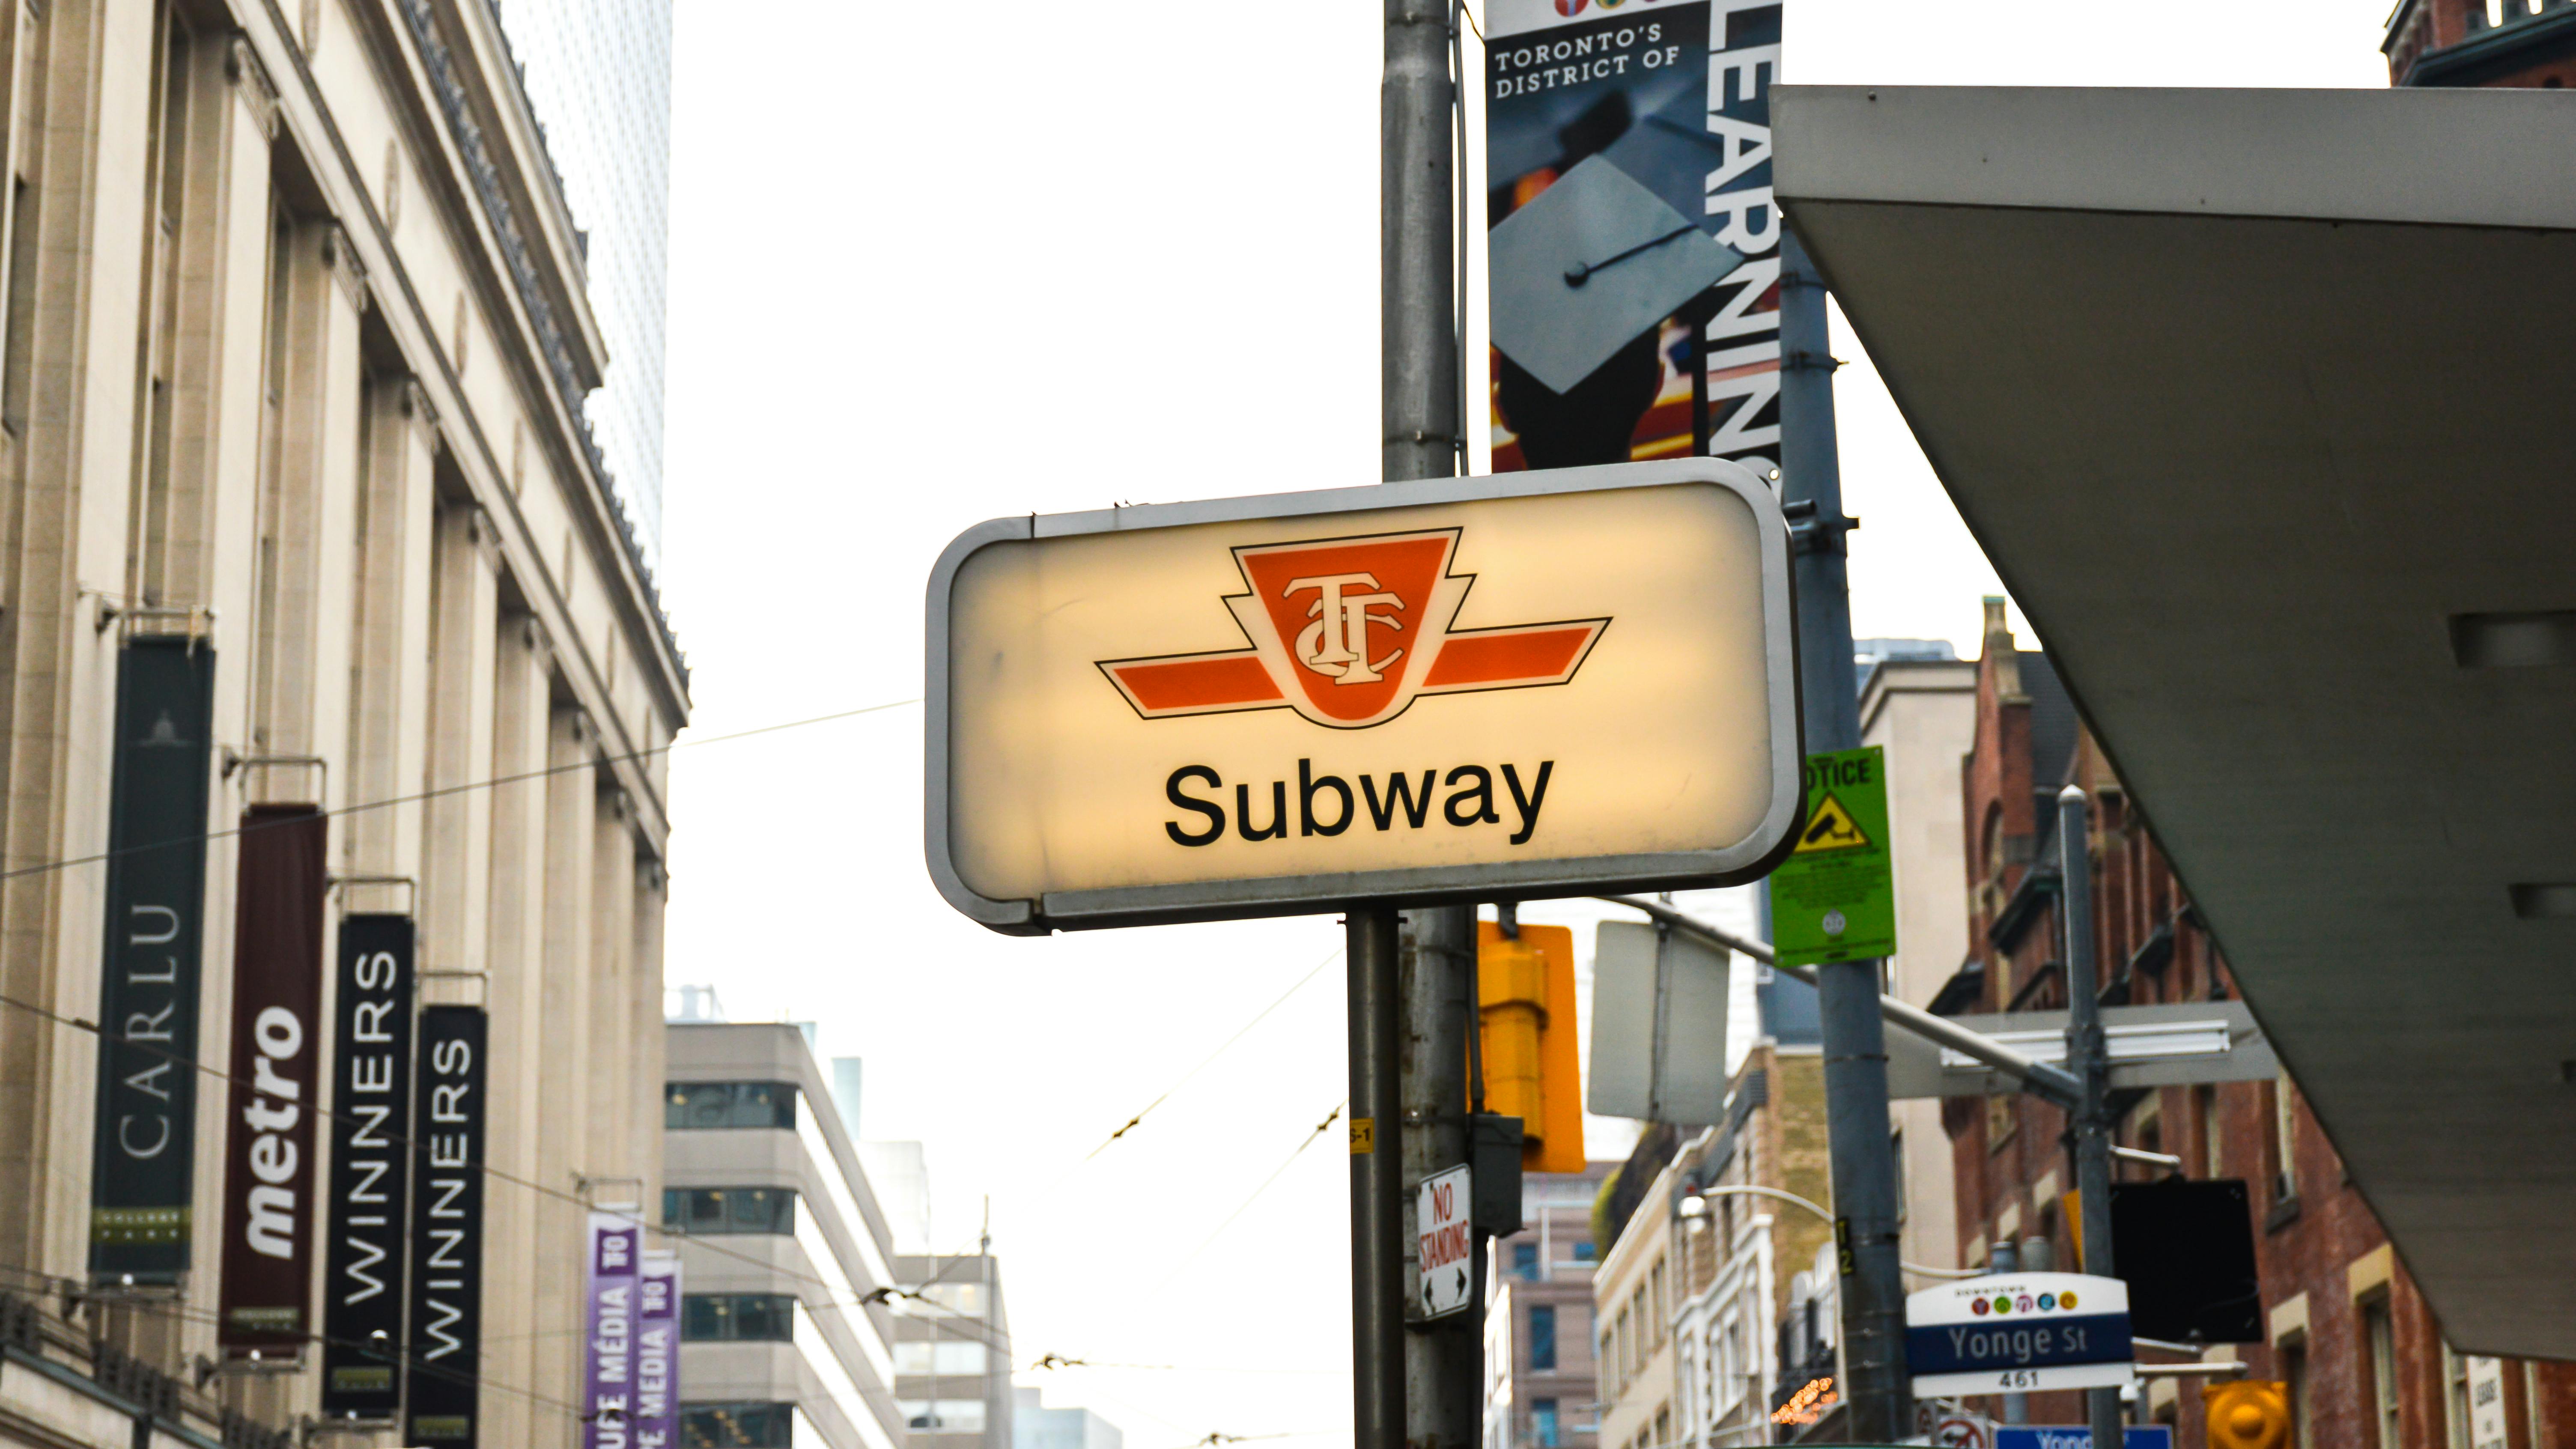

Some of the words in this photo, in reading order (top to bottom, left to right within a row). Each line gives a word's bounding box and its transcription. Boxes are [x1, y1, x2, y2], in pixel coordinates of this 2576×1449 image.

[1495, 24, 1662, 72] TORONTO'S
[1496, 55, 1630, 99] DISTRICT
[1643, 46, 1680, 69] OF
[1705, 0, 1781, 500] LEARNIN
[1164, 758, 1554, 847] Subway
[1806, 757, 1872, 790] OTICE
[120, 904, 181, 1158] CARLU
[245, 1005, 304, 1260] metro
[345, 950, 397, 1306] WINNERS
[425, 1038, 471, 1360] WINNERS
[1433, 1183, 1454, 1225] NO
[1419, 1219, 1469, 1273] STANDING
[592, 1286, 629, 1383] MÉDIA
[638, 1328, 668, 1418] MEDIA
[1948, 1327, 2052, 1364] Yonge
[2063, 1326, 2087, 1353] St
[1999, 1371, 2039, 1388] 461
